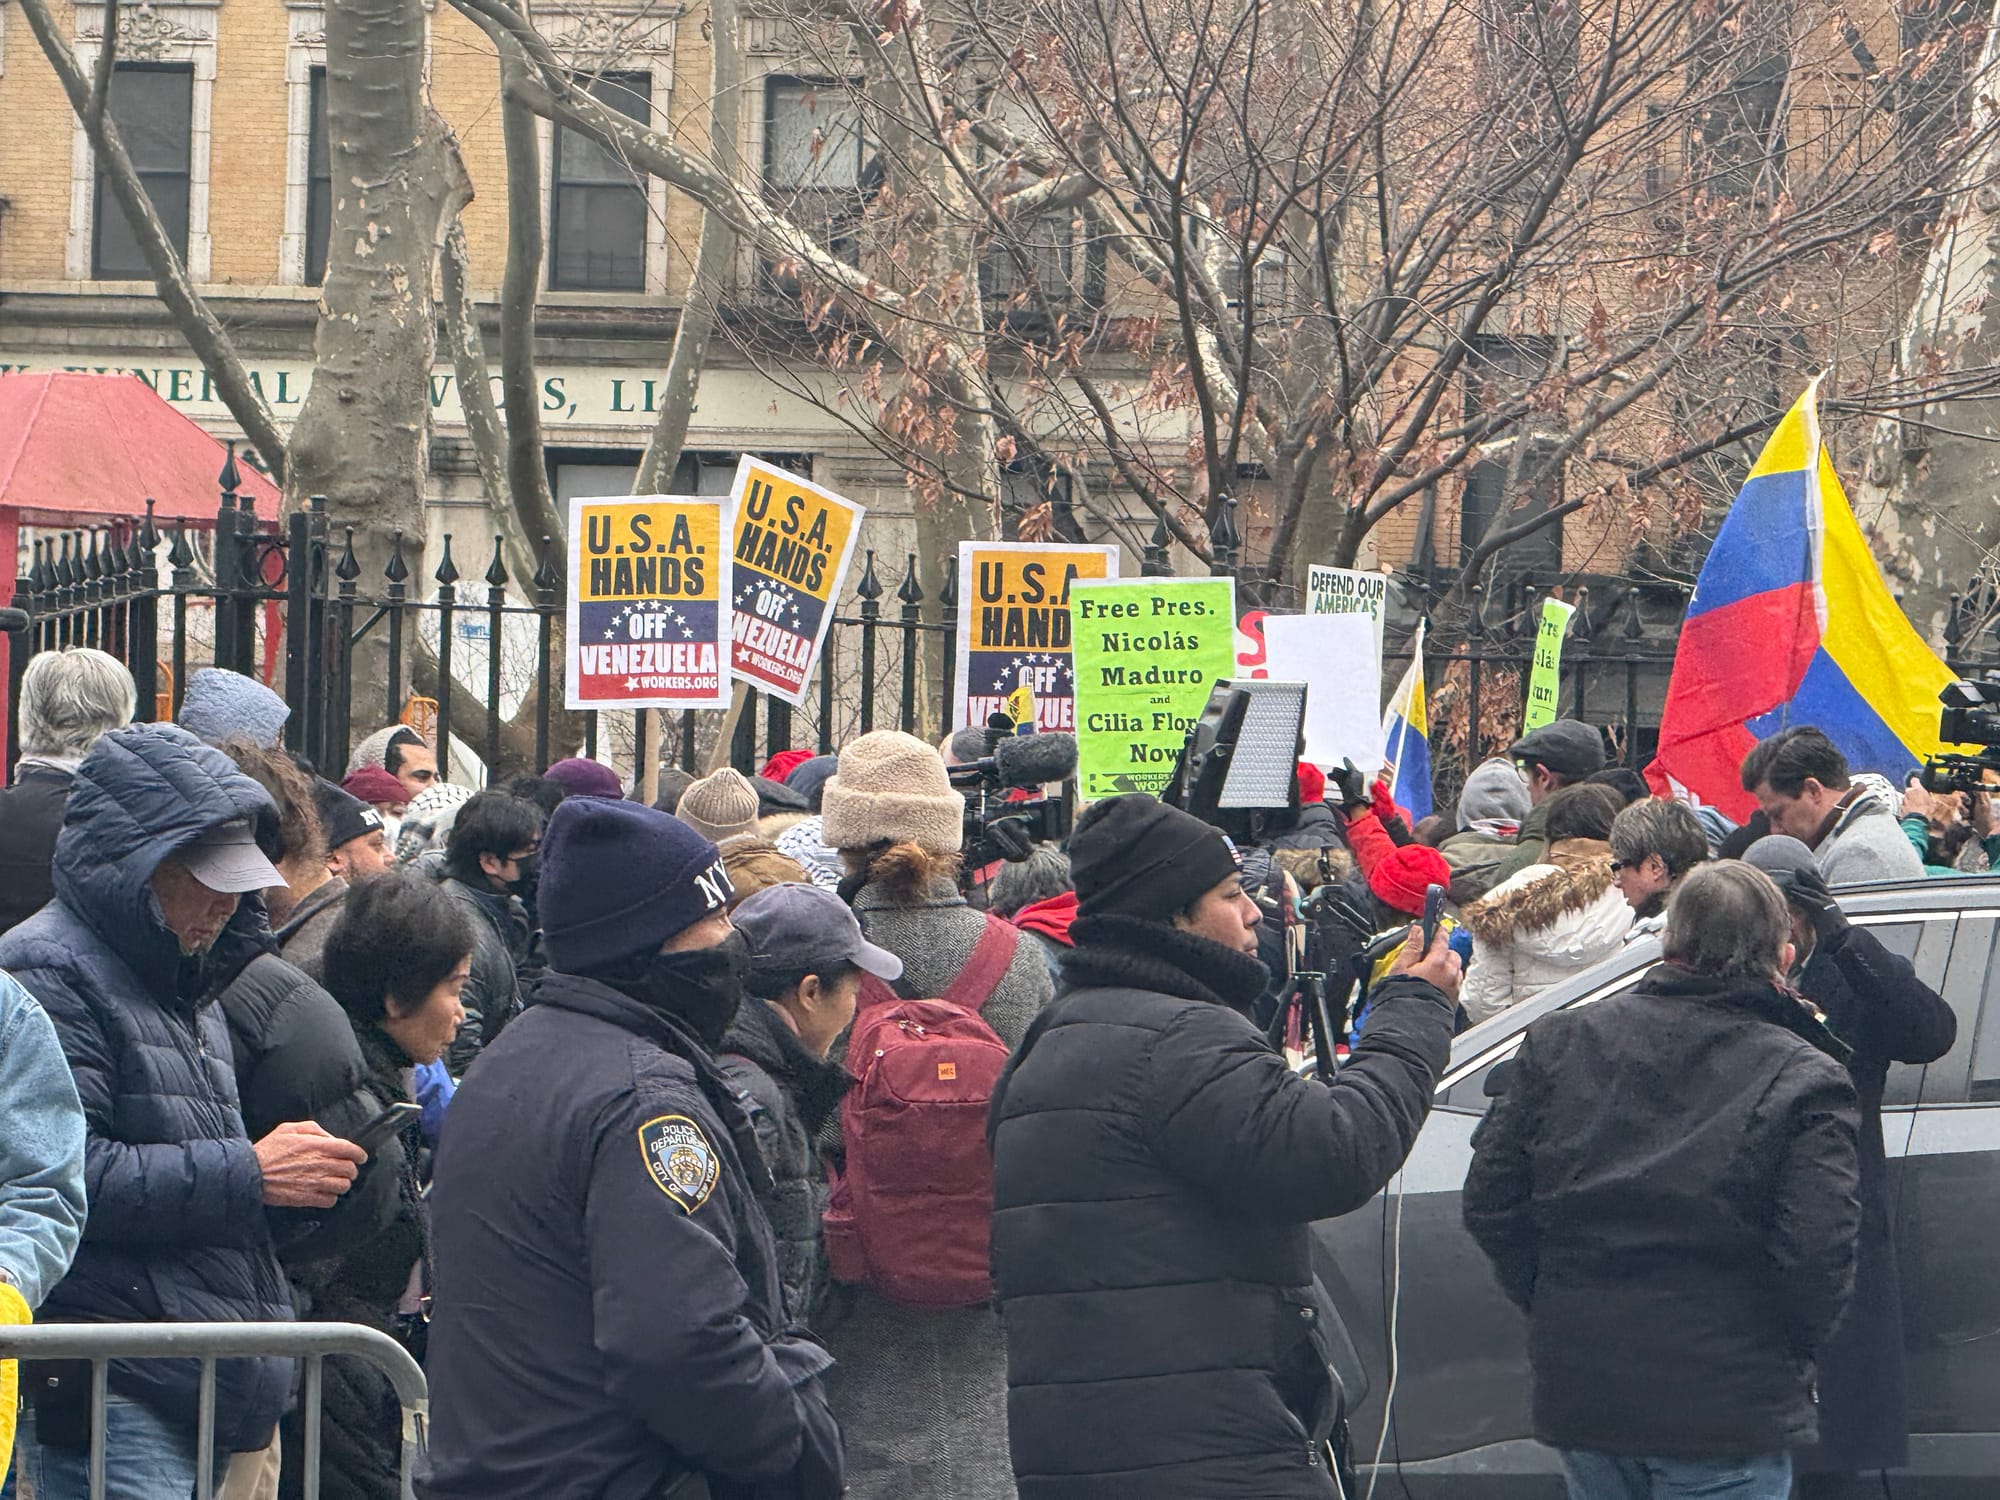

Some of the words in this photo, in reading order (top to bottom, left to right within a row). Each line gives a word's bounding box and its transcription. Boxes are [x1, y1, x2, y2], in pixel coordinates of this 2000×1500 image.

[62, 366, 301, 405] NERAL
[609, 379, 698, 412] LL
[747, 479, 833, 554] U.S.A.
[588, 512, 705, 555] U.S.A.
[735, 521, 828, 592] HANDS
[590, 556, 705, 597] HANDS
[1311, 571, 1355, 596] DEFEND
[1357, 577, 1384, 600] OUR
[755, 589, 787, 622] OFF
[1080, 599, 1140, 619] Free
[1150, 597, 1216, 616] Pres.
[1314, 593, 1378, 622] AMERICAS
[628, 612, 668, 640] OFF
[732, 609, 812, 671] NEZUELA
[981, 606, 1072, 648] HAND
[1101, 630, 1199, 653] Nicolás
[580, 643, 718, 676] VENEZUELA
[641, 676, 718, 690] WORKERS.ORG
[1018, 665, 1057, 693] OFF
[1100, 666, 1204, 688] Maduro
[1150, 695, 1171, 704] and
[1087, 713, 1144, 733] Cilia
[1151, 713, 1198, 732] Flor
[1129, 743, 1182, 764] Now
[662, 1125, 697, 1136] POLICE
[653, 1161, 671, 1182] CITY
[668, 1183, 683, 1194] OF
